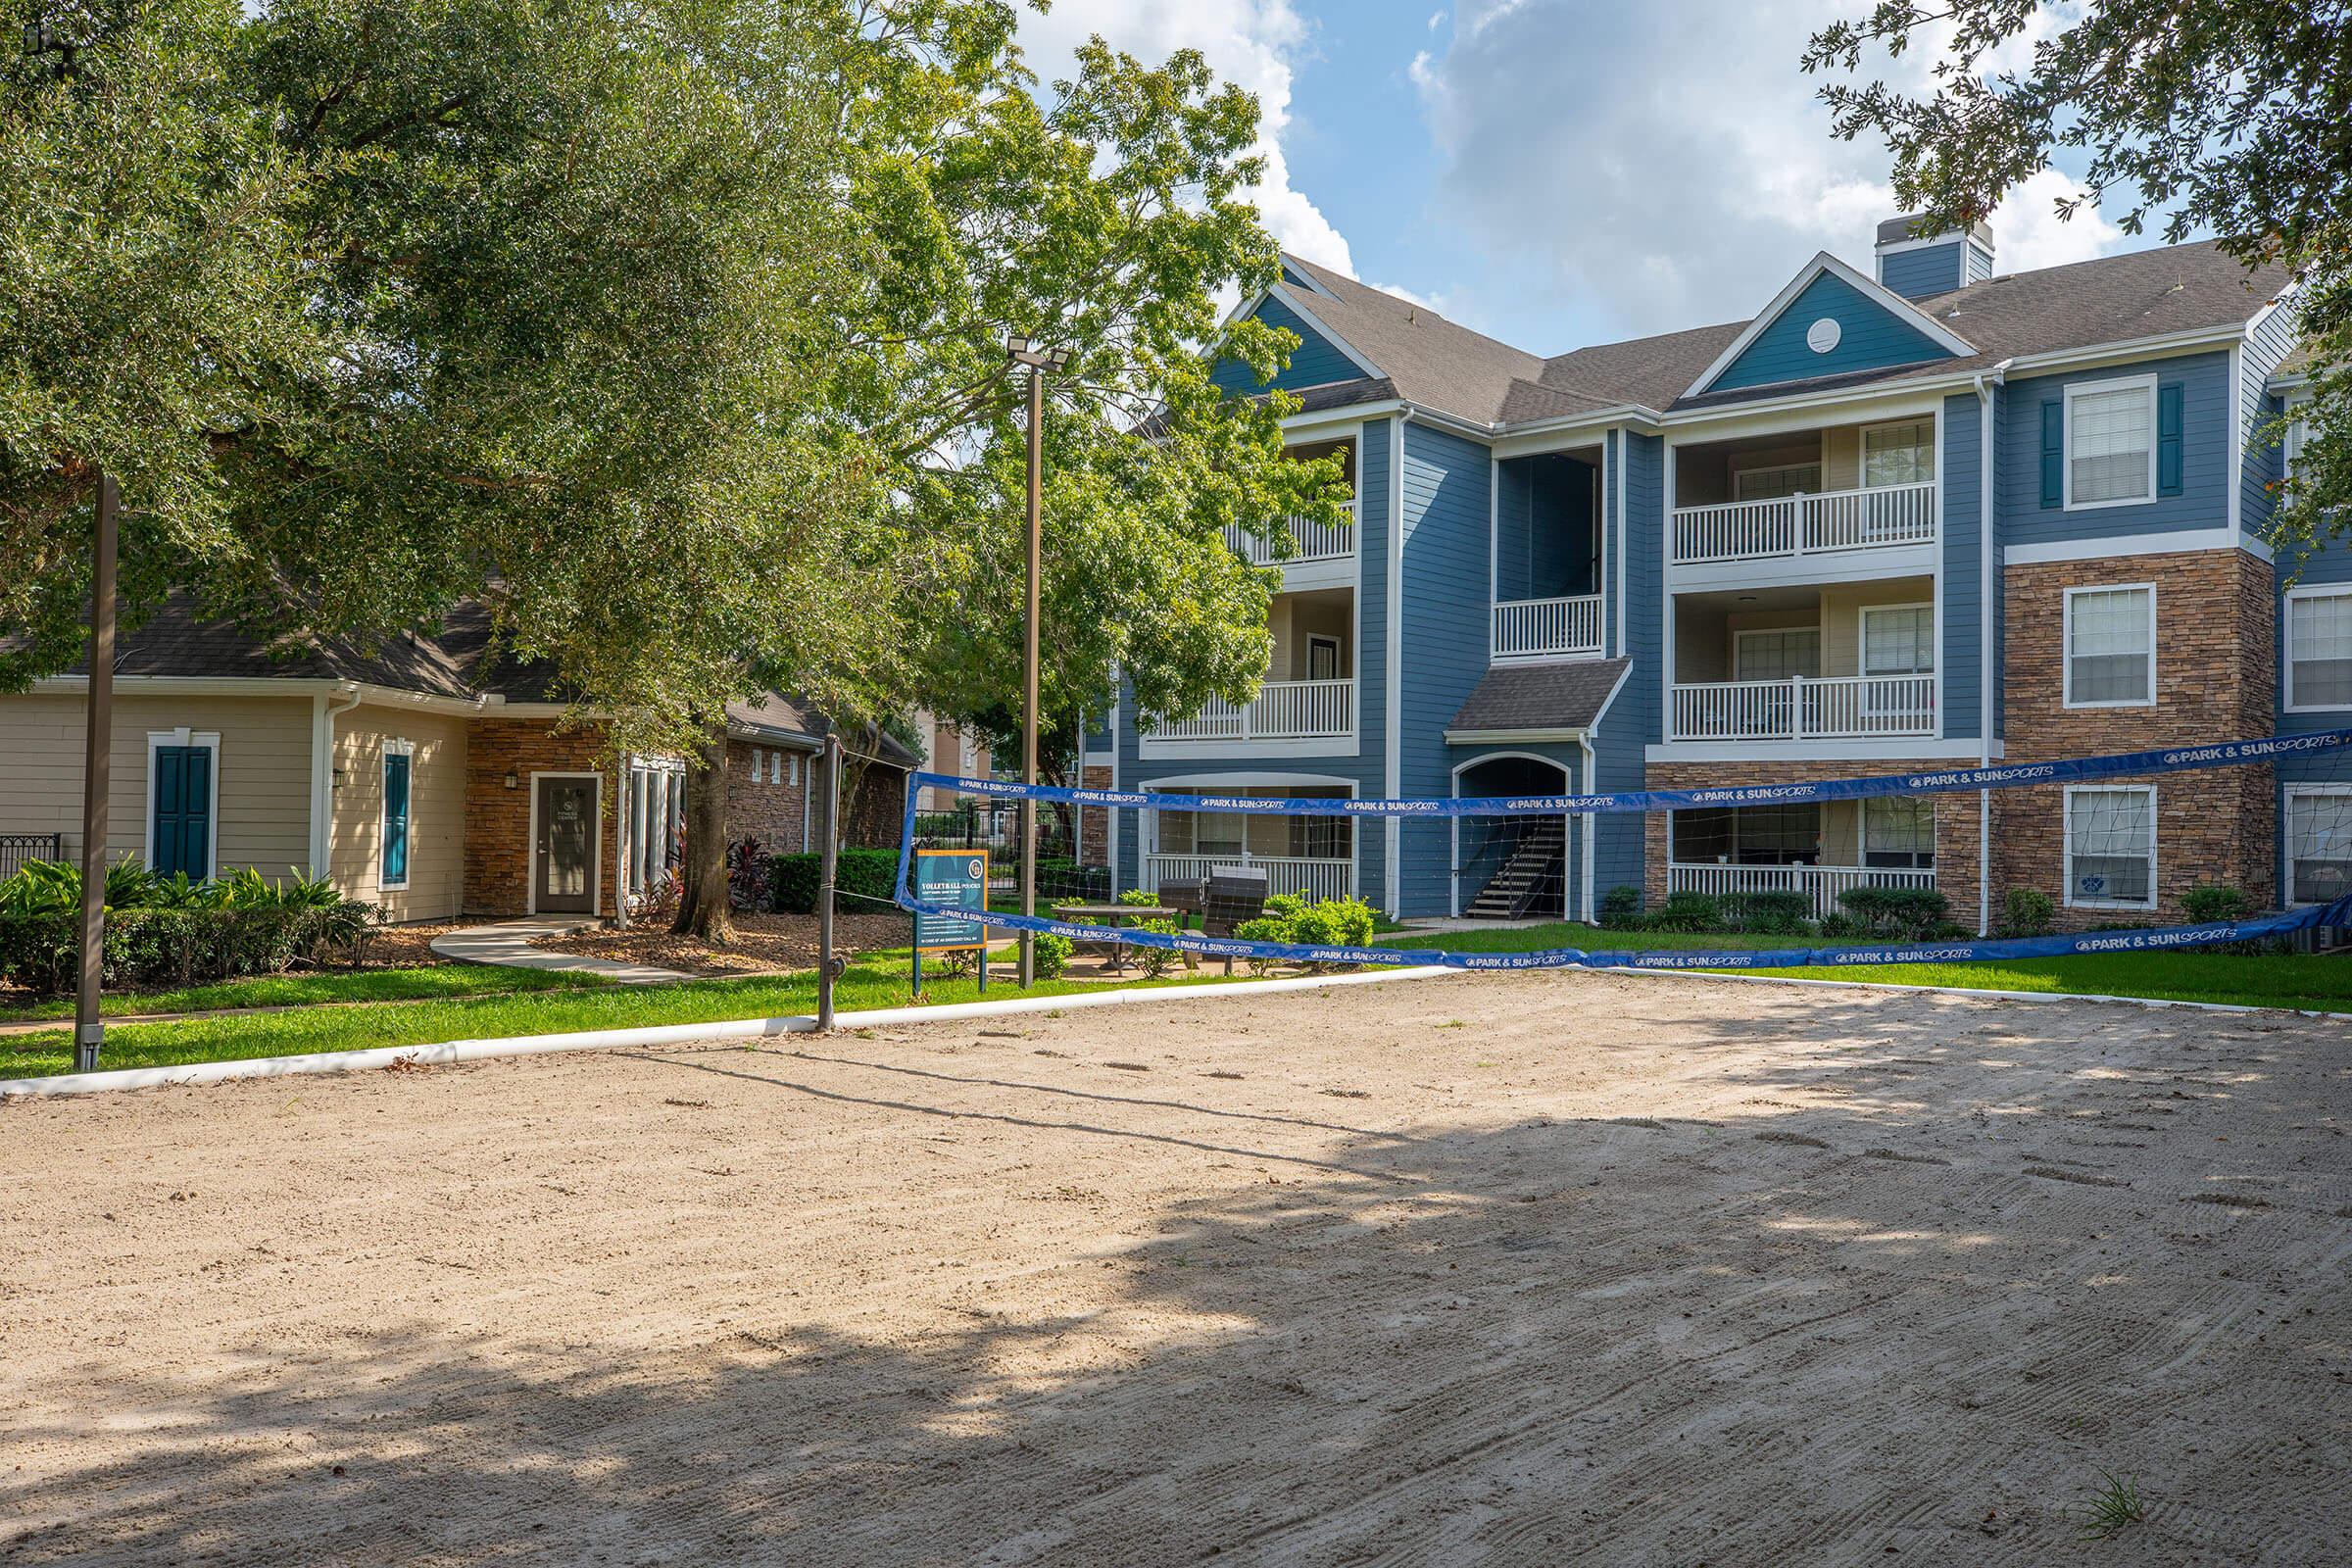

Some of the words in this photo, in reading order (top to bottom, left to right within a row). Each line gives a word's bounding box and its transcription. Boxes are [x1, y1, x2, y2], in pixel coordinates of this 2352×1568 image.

[2180, 748, 2223, 762] PARK
[2225, 747, 2238, 759] &
[964, 780, 982, 789] PARK
[1923, 774, 1958, 787] PARK
[1960, 773, 1971, 784] &
[1080, 792, 1100, 801] PARK
[1704, 791, 1735, 802] PARK
[1736, 791, 1744, 800] &
[1208, 798, 1231, 808] PARK
[1231, 800, 1238, 808] &
[1353, 802, 1377, 810] PARK
[1378, 802, 1385, 810] &
[1518, 800, 1544, 808] PARK
[1544, 800, 1553, 808] &
[947, 910, 961, 919] PARK
[1057, 926, 1076, 936] PARK
[1076, 928, 1082, 937] &
[1180, 941, 1200, 951] PARK
[2092, 938, 2131, 951] PARK
[2133, 937, 2144, 948] &
[1319, 951, 1343, 959] PARK
[1850, 953, 1883, 962] PARK
[1884, 953, 1893, 961] &
[1476, 958, 1500, 967] PARK
[1502, 958, 1510, 967] &
[1646, 957, 1673, 966] PARK
[1677, 957, 1685, 966] &
